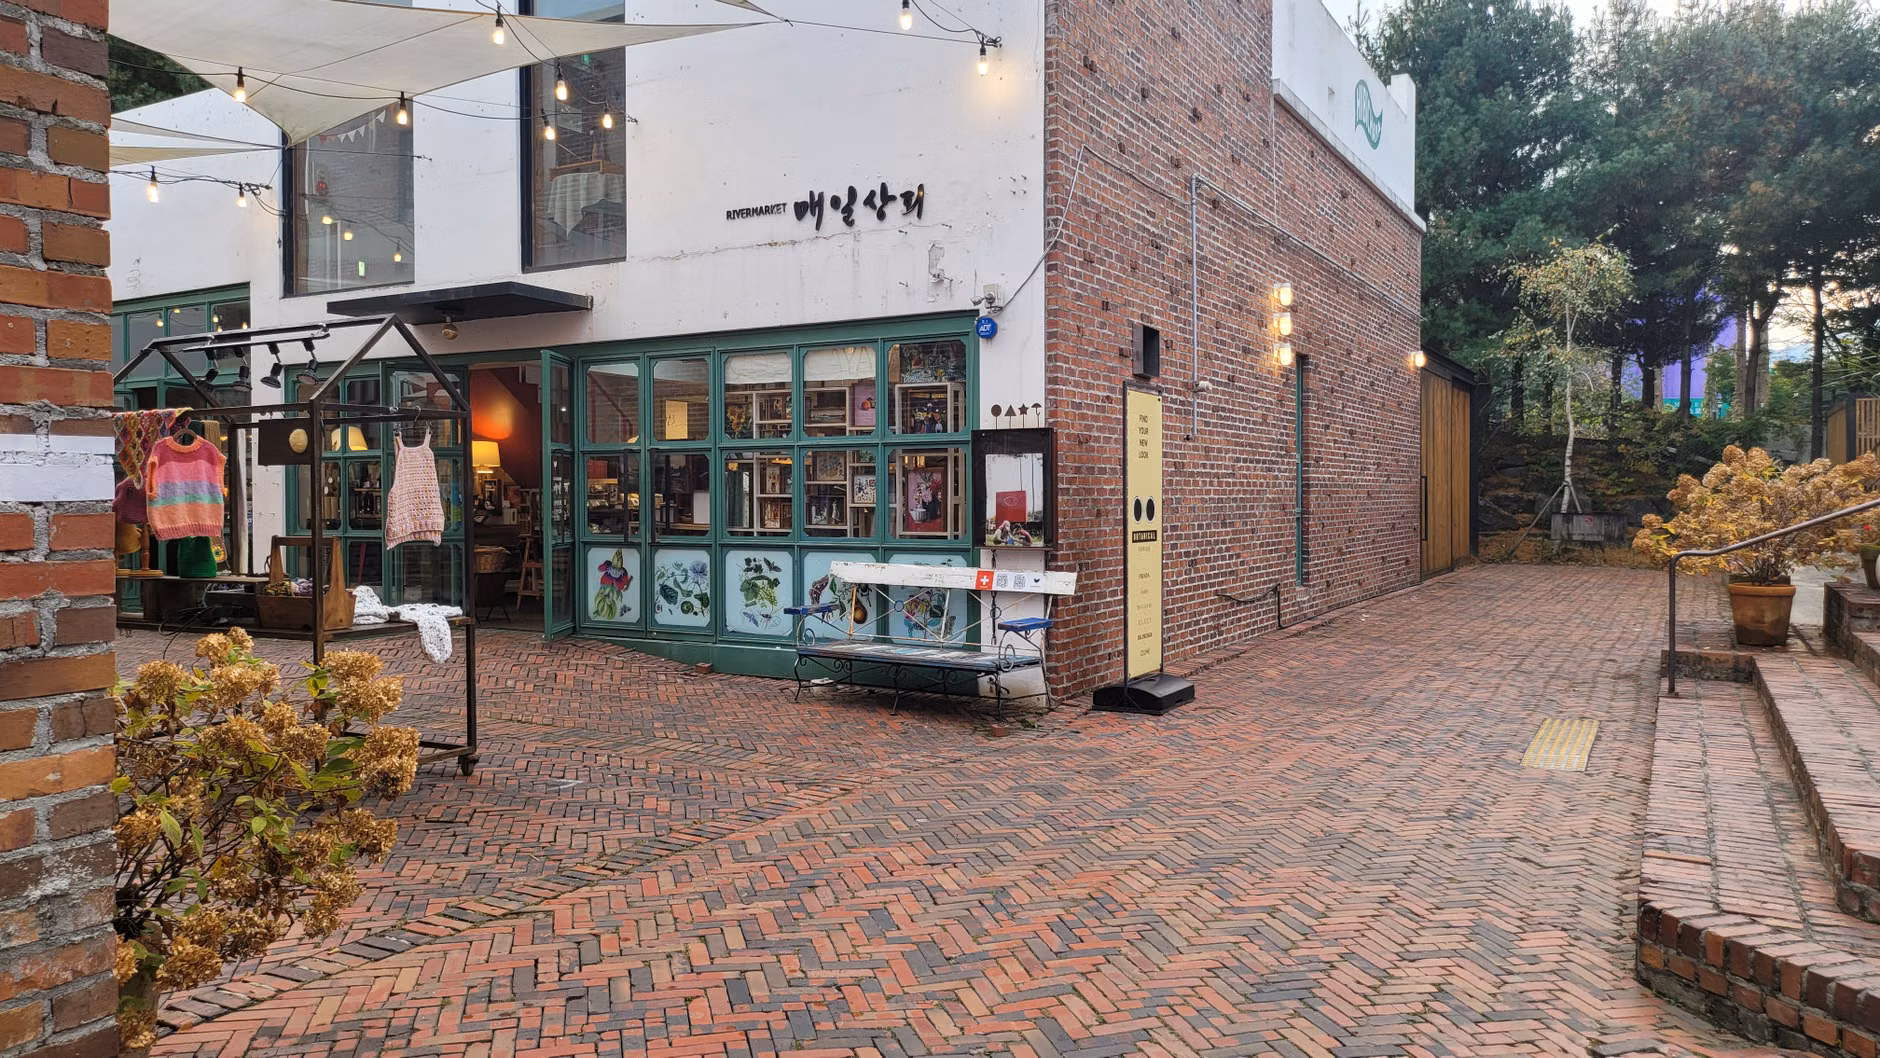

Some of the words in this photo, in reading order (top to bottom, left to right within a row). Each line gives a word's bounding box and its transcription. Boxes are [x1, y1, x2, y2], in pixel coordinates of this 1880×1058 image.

[726, 202, 787, 221] RIVERMARKET
[979, 323, 992, 332] ADT
[1138, 414, 1148, 423] FIND
[1138, 427, 1149, 435] YOUR
[1139, 439, 1148, 447] NEW
[1138, 451, 1149, 459] LOOK
